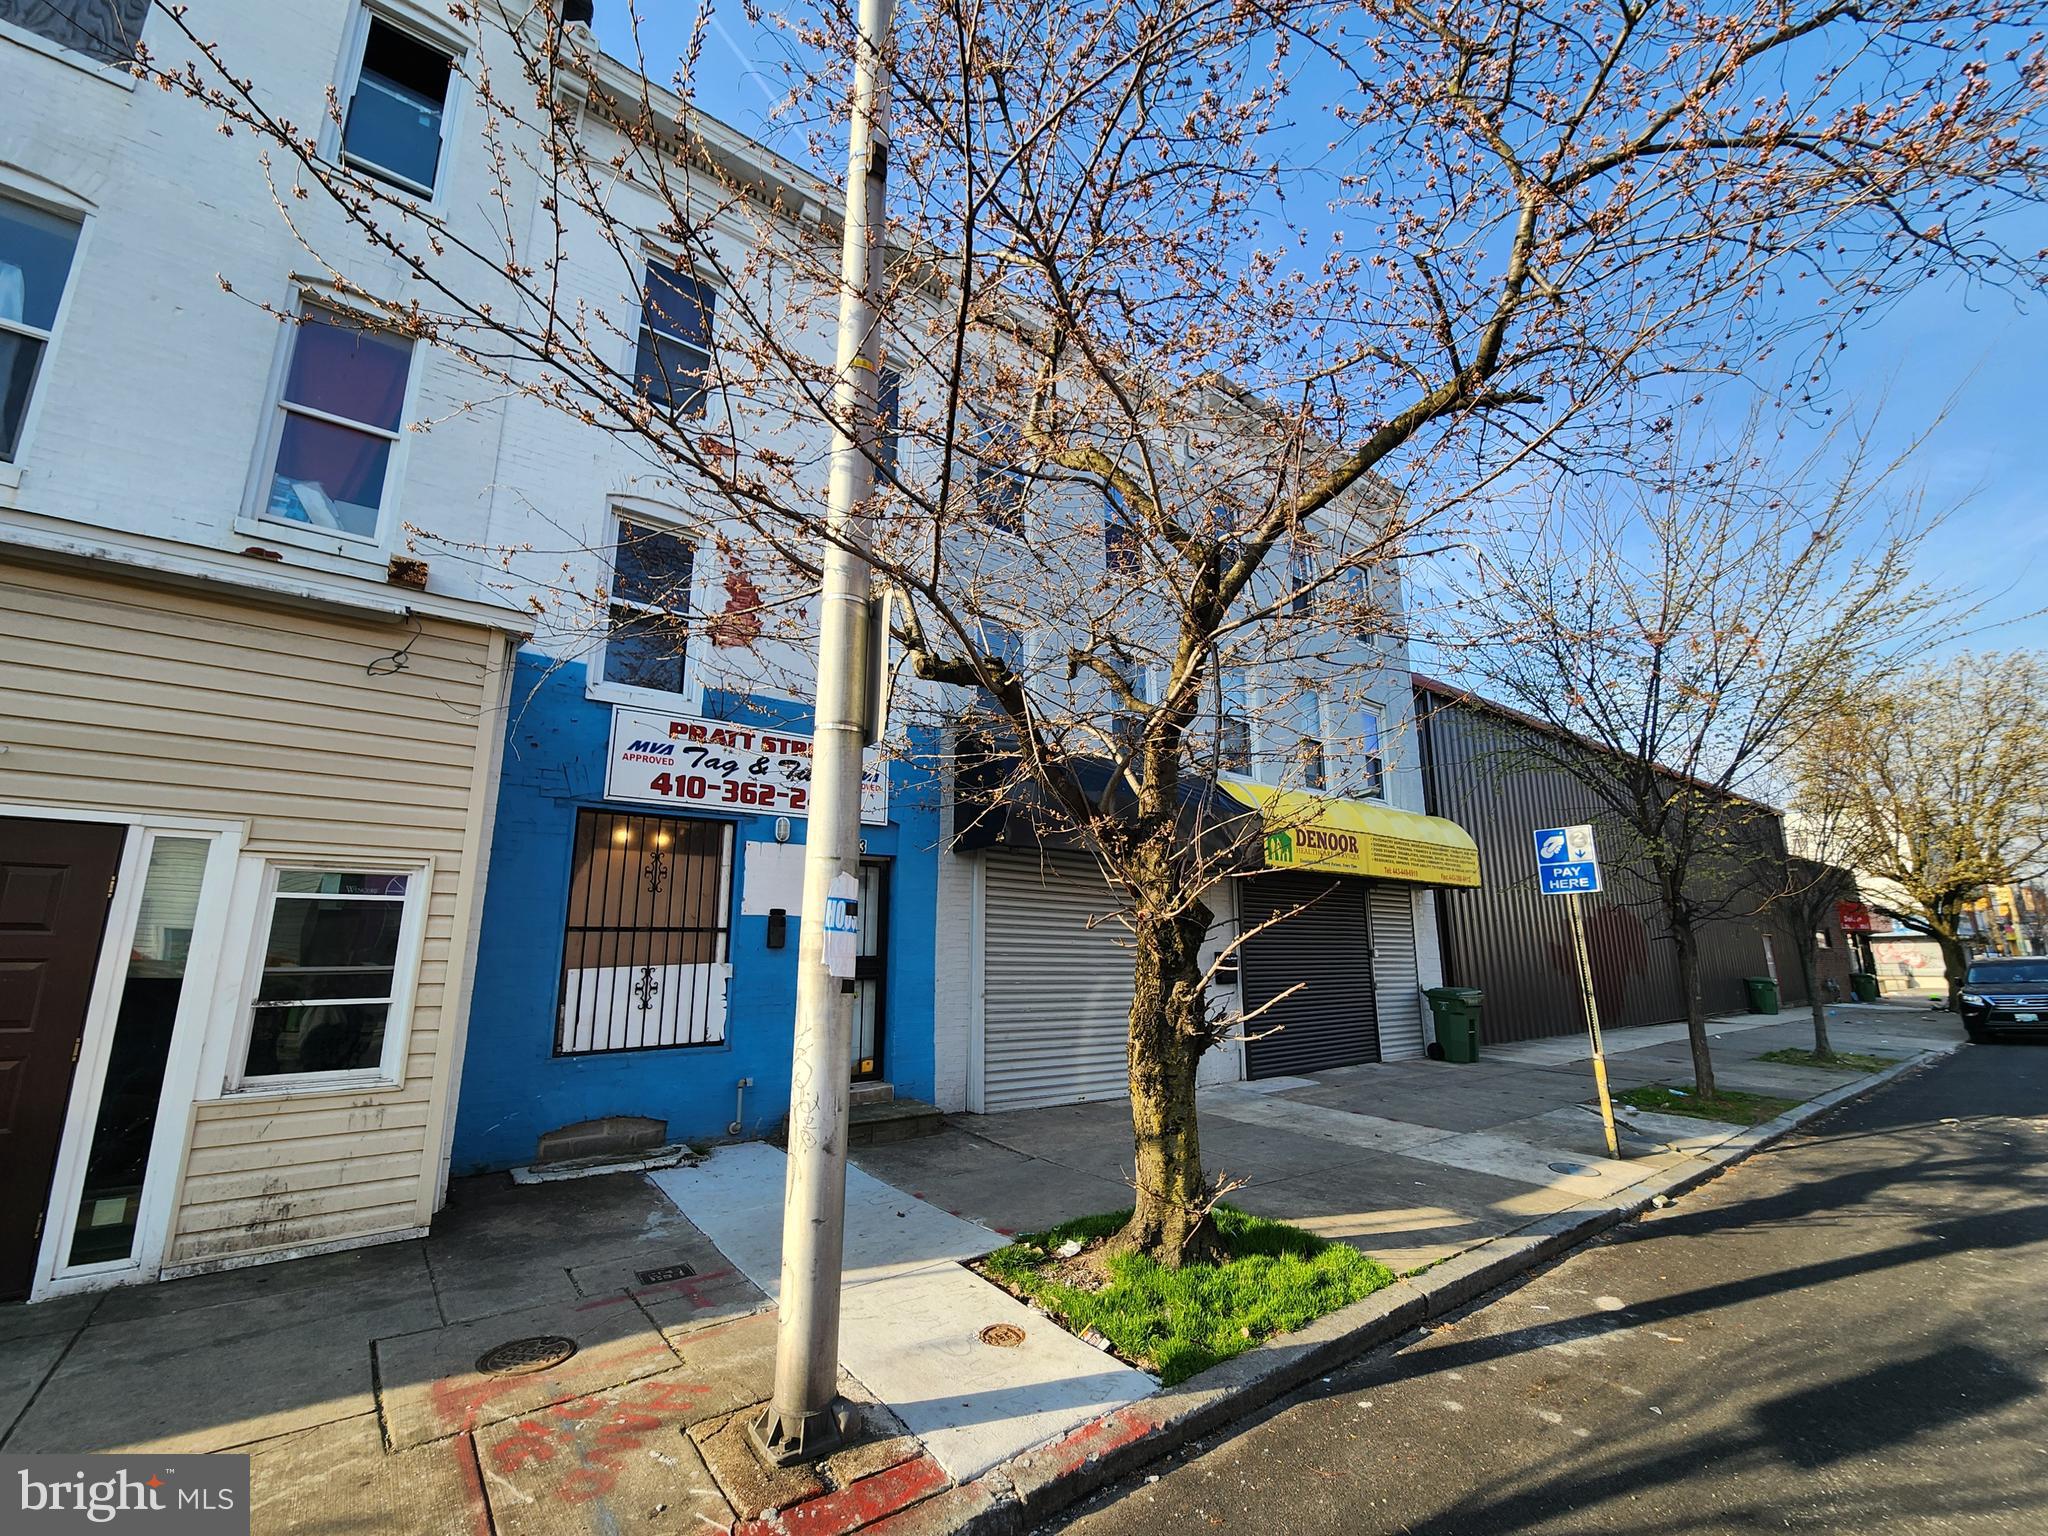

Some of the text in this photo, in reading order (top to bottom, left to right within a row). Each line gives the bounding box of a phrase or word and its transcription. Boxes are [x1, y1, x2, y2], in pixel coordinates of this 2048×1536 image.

[669, 721, 756, 750] PRATT
[626, 740, 675, 755] MVA
[622, 752, 674, 766] APPROVED
[683, 746, 740, 778] Tag
[748, 756, 770, 776] &
[650, 772, 810, 809] 410-362-2
[1296, 828, 1358, 854] DENOOR
[1553, 866, 1581, 877] PAY
[1550, 878, 1590, 889] HERE
